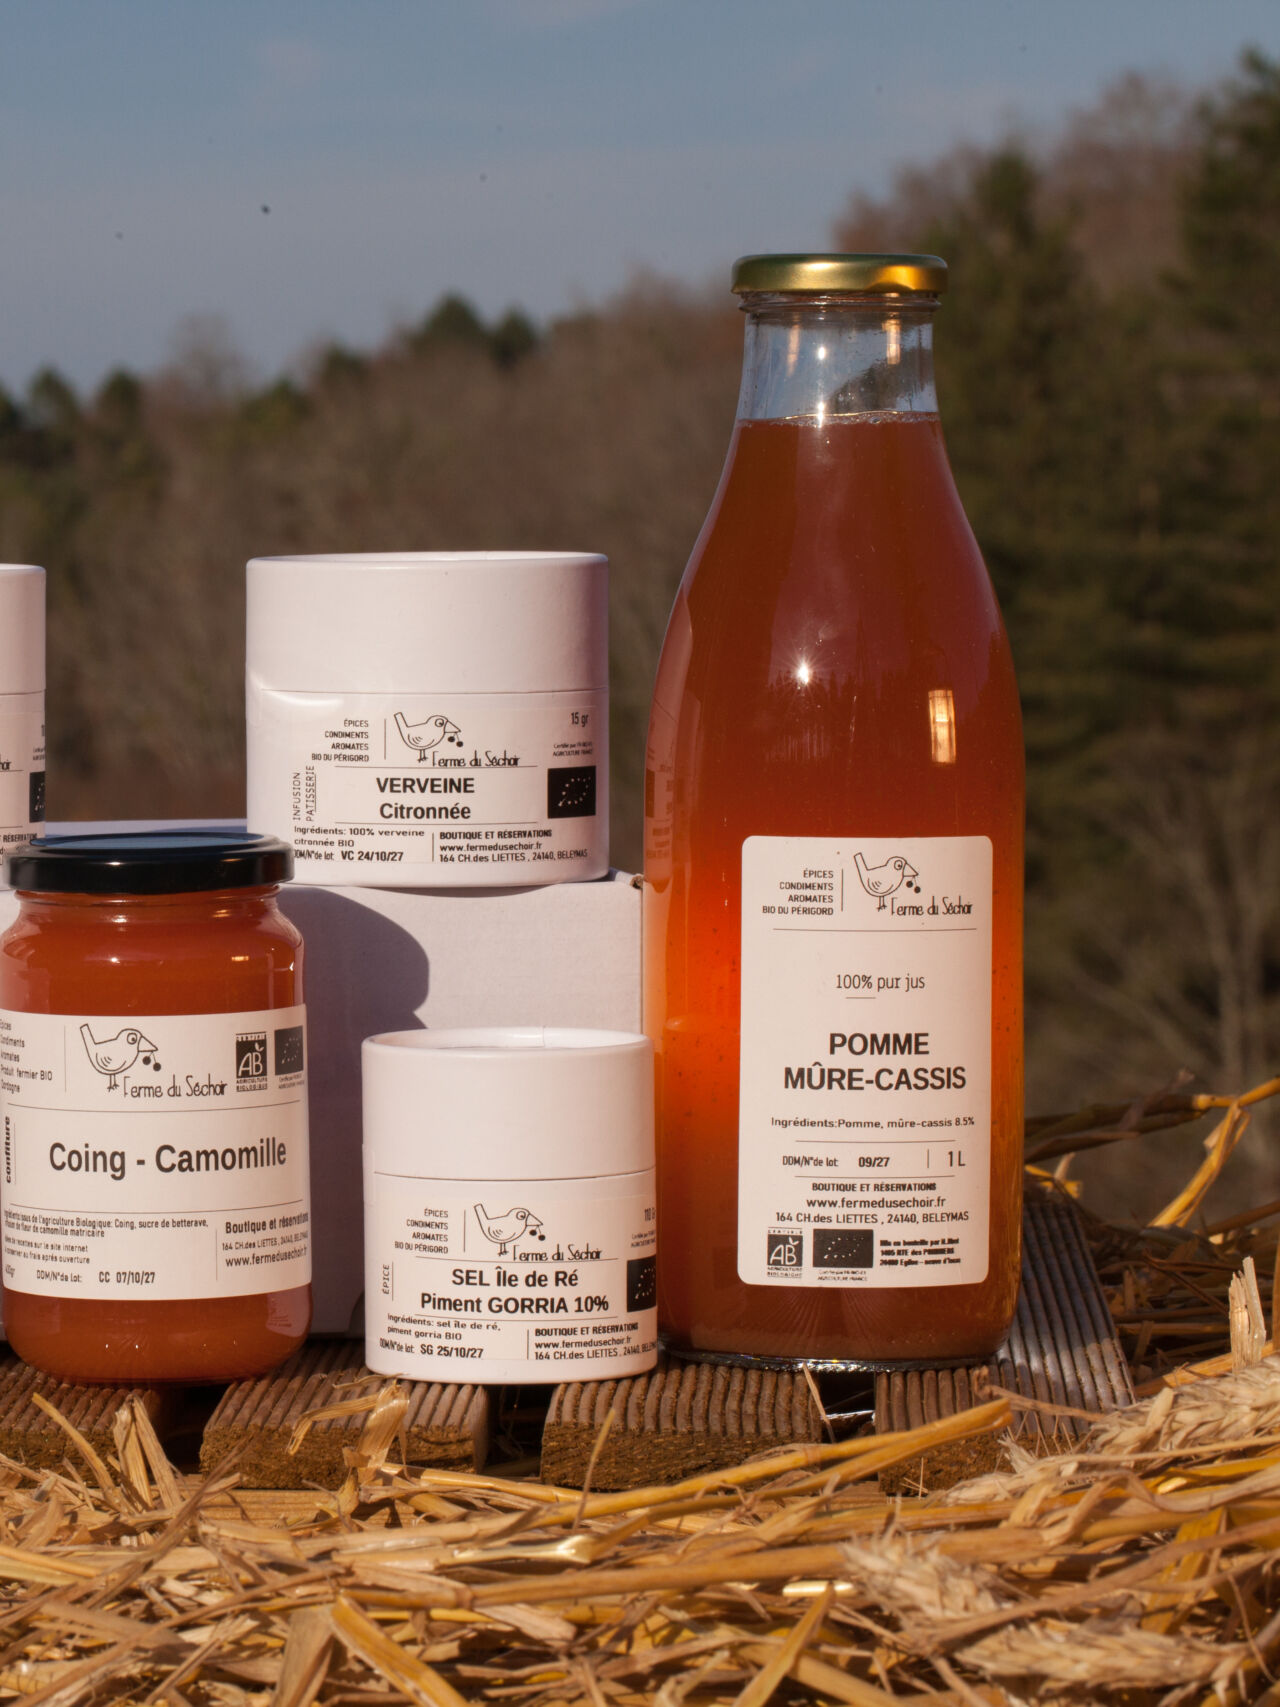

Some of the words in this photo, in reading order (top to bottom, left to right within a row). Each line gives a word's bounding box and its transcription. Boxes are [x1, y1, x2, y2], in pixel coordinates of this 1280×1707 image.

[571, 712, 579, 725] 15
[580, 714, 588, 727] gr
[432, 751, 466, 767] Ferme
[470, 750, 481, 767] du
[485, 750, 520, 767] Séchoir
[376, 777, 475, 793] VERVEINE
[292, 772, 301, 820] INFUSION
[306, 765, 314, 822] PATISSERIE
[379, 802, 471, 820] Citronnée
[294, 826, 347, 835] Ingrédients:
[349, 827, 375, 836] 100%
[378, 829, 425, 837] verveine
[294, 837, 335, 847] citronnée
[338, 839, 354, 848] BIO
[440, 841, 543, 852] www.fermedusechoir.fr
[341, 851, 355, 861] VC
[357, 851, 404, 862] 24/10/27
[803, 869, 834, 879] ÉPICES
[779, 882, 834, 891] CONDIMENTS
[788, 894, 834, 903] AROMATES
[891, 897, 924, 916] Ferme
[927, 895, 939, 916] du
[942, 895, 973, 915] Séchoir
[762, 905, 776, 914] BIO
[778, 905, 789, 914] DU
[791, 904, 834, 916] PÉRIGORD
[836, 974, 873, 989] 100%
[877, 976, 901, 993] pur
[905, 973, 925, 992] jus
[829, 1032, 930, 1056] POMME
[784, 1061, 967, 1090] MÛRE-CASSIS
[123, 1075, 163, 1098] Ferme
[167, 1074, 182, 1097] du
[186, 1073, 227, 1097] Séchoir
[887, 1117, 953, 1128] mûre-cassis
[955, 1117, 974, 1126] 8.5%
[49, 1141, 126, 1181] Coing
[155, 1137, 286, 1174] Camomille
[858, 1156, 890, 1168] 09/27
[812, 1183, 857, 1192] BOUTIQUE
[860, 1183, 871, 1192] ET
[873, 1181, 936, 1192] RÉSERVATIONS
[806, 1196, 946, 1209] www.fermedusechoir.fr
[776, 1212, 793, 1222] 164
[922, 1211, 969, 1223] BELEYMAS
[226, 1218, 267, 1234] Boutique
[116, 1271, 155, 1285] 07/10/27
[382, 1263, 390, 1295] ÉPICE
[452, 1268, 490, 1286] SEL
[496, 1265, 519, 1287] Île
[524, 1269, 548, 1287] de
[555, 1269, 579, 1286] Ré
[421, 1293, 481, 1313] Piment
[488, 1296, 569, 1314] GORRIA
[574, 1295, 609, 1313] 10%
[387, 1312, 434, 1327] Ingrédients:
[436, 1319, 450, 1328] sel
[454, 1320, 466, 1329] île
[470, 1321, 483, 1329] de
[486, 1321, 501, 1331] ré,
[387, 1325, 412, 1336] piment
[414, 1330, 443, 1340] gorria
[444, 1332, 462, 1340] BIO
[420, 1343, 433, 1355] SG
[437, 1344, 484, 1359] 25/10/27
